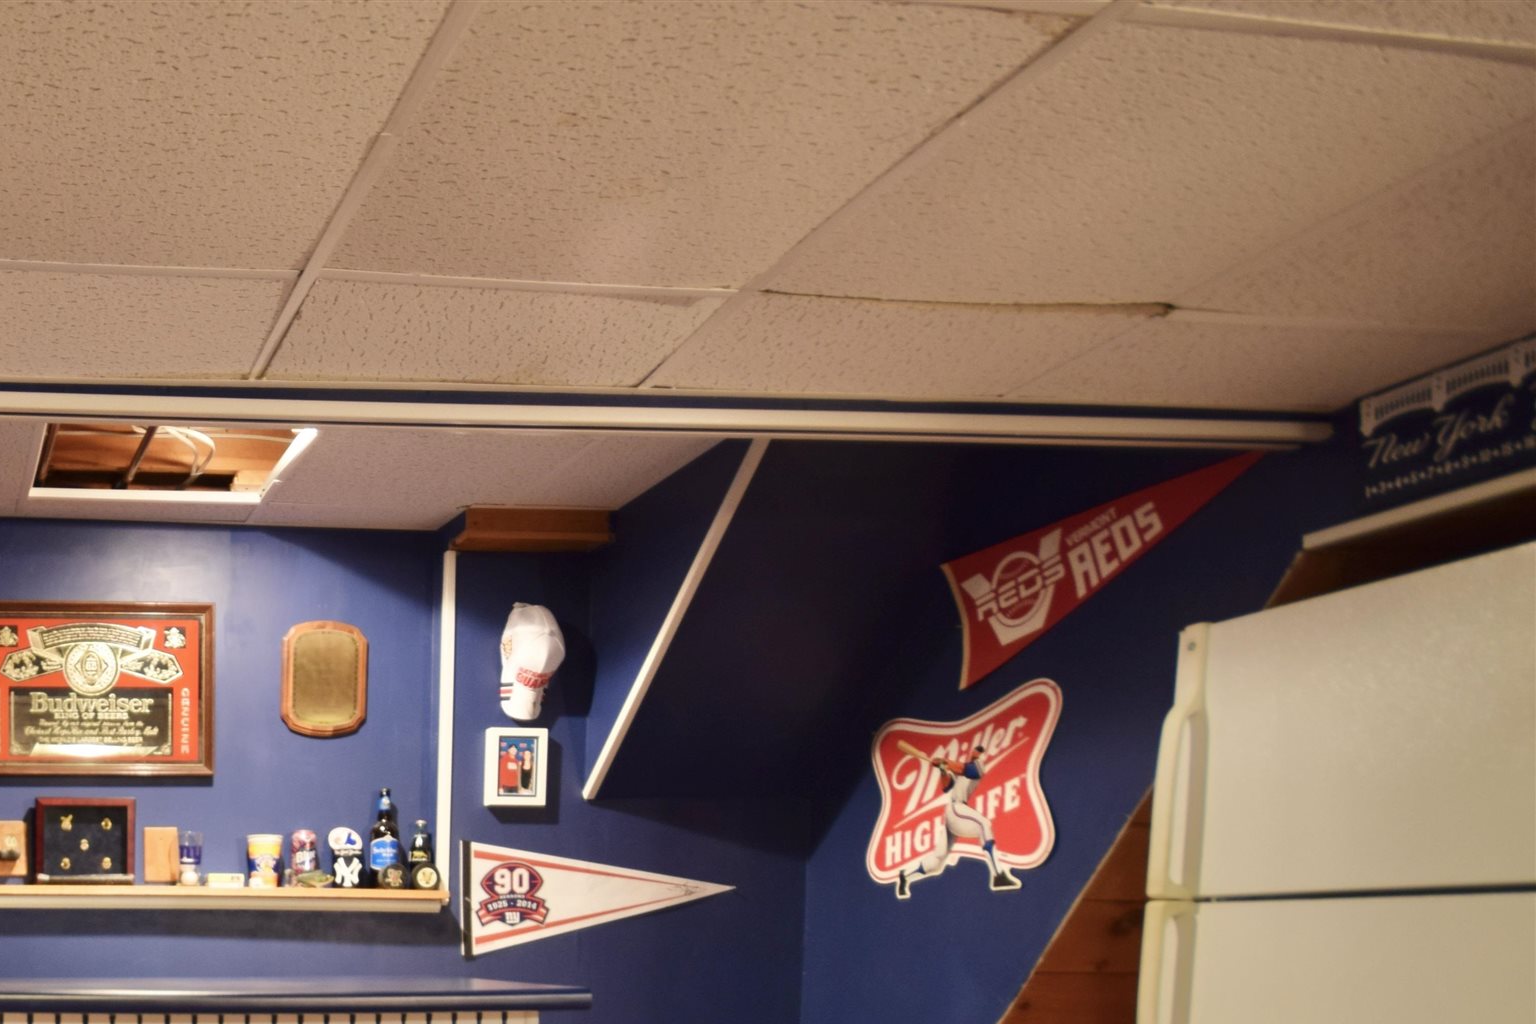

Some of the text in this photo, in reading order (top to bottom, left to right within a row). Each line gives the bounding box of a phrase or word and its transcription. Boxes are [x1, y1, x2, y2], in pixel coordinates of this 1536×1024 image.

[1067, 501, 1163, 599] REDS
[975, 554, 1064, 621] REDS
[29, 692, 154, 713] Budweiser
[181, 687, 190, 754] GENUINE
[892, 715, 1028, 816] Miller
[975, 777, 1022, 820] IFE
[494, 868, 530, 895] 90
